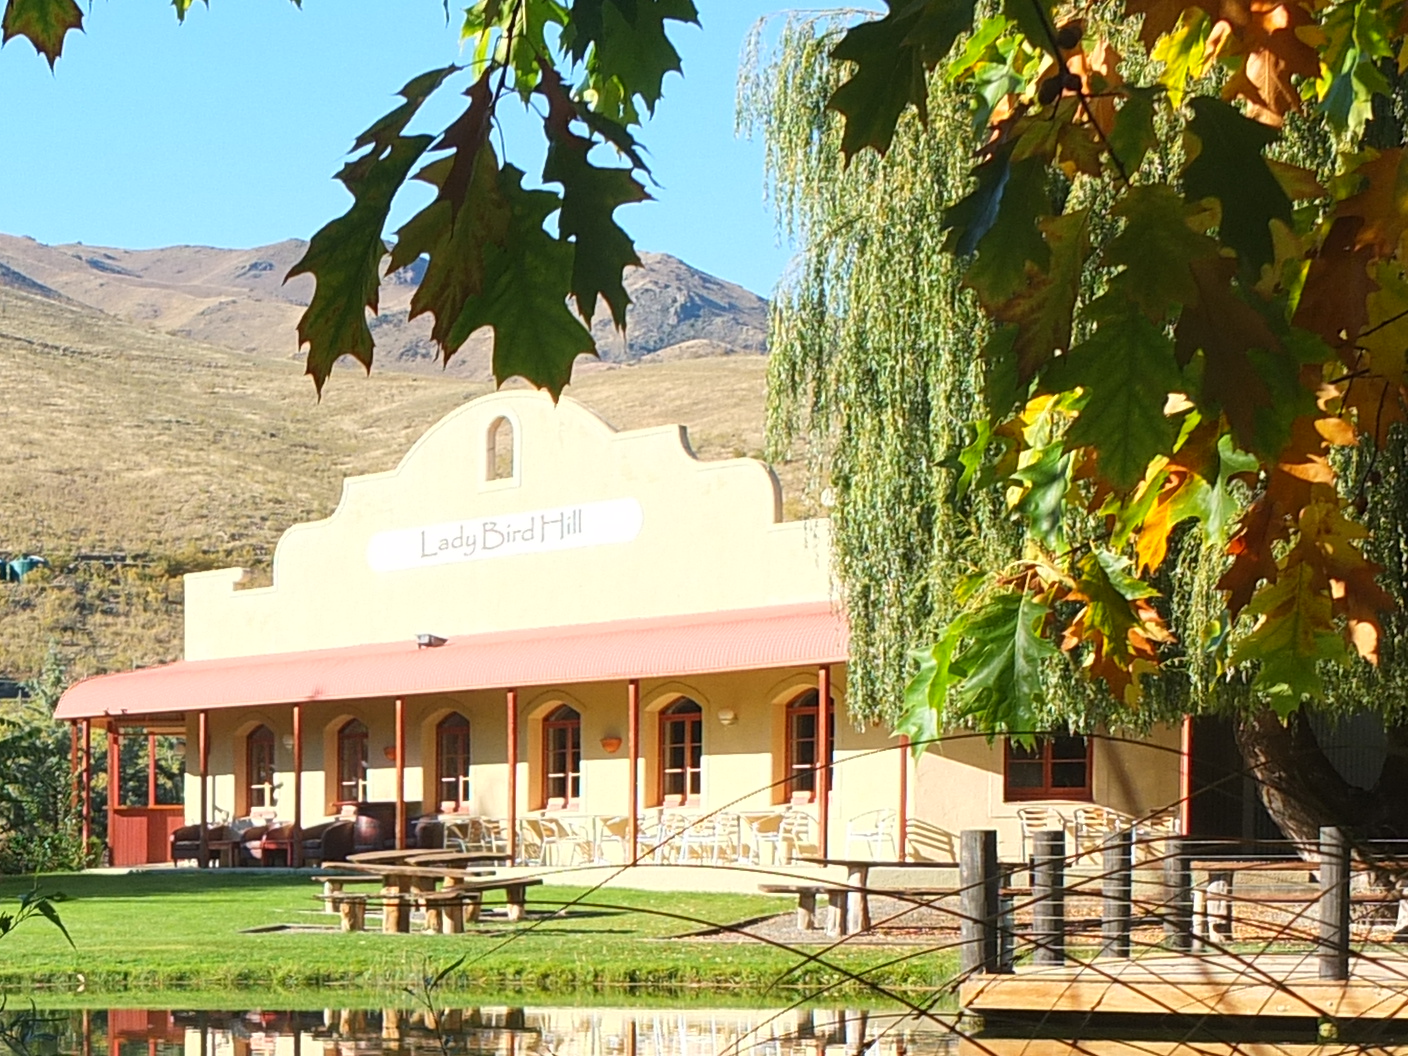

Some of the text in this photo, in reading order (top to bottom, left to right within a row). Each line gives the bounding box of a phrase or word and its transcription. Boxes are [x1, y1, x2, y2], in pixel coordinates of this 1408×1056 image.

[420, 509, 582, 558] Lady Bird Hill
